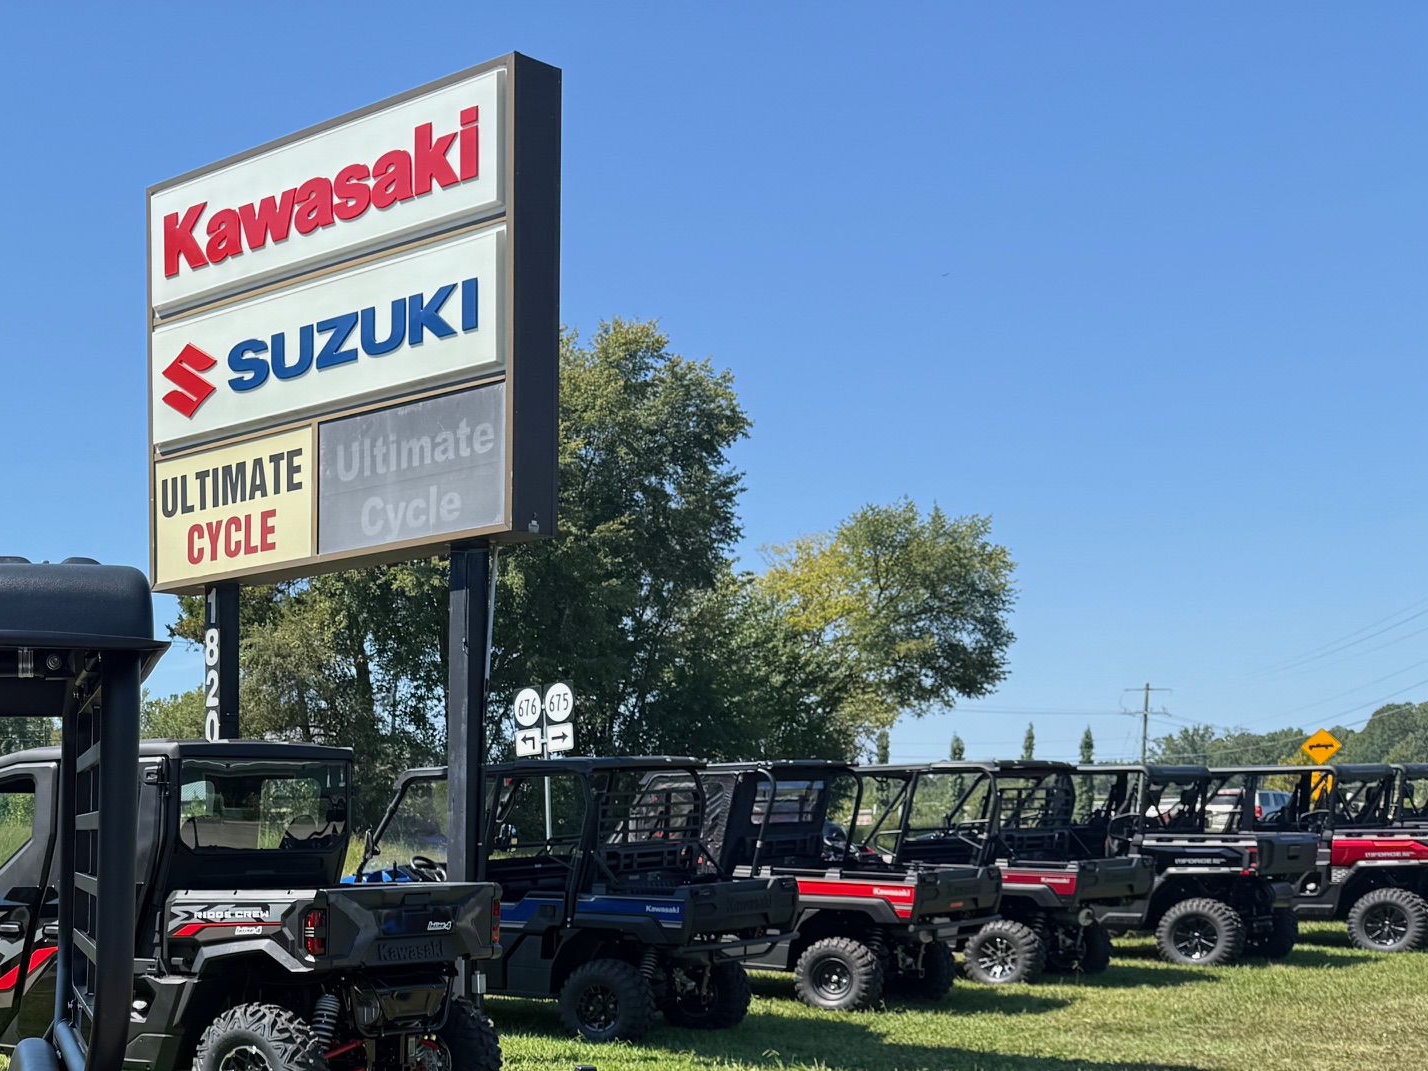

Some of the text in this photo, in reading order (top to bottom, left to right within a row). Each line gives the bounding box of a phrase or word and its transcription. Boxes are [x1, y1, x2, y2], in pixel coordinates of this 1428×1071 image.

[164, 105, 479, 278] Kawasaki
[227, 277, 479, 392] SUZUKI
[336, 417, 495, 482] Ultimate
[161, 447, 303, 518] ULTIMATE
[187, 508, 277, 566] CYCLE
[360, 487, 462, 542] Cycle
[205, 587, 220, 742] 1820
[518, 697, 537, 717] 676
[549, 692, 569, 712] 675
[194, 910, 269, 919] RIDGE CREW
[645, 905, 680, 914] Kawasaki
[377, 939, 445, 961] Kawasaki
